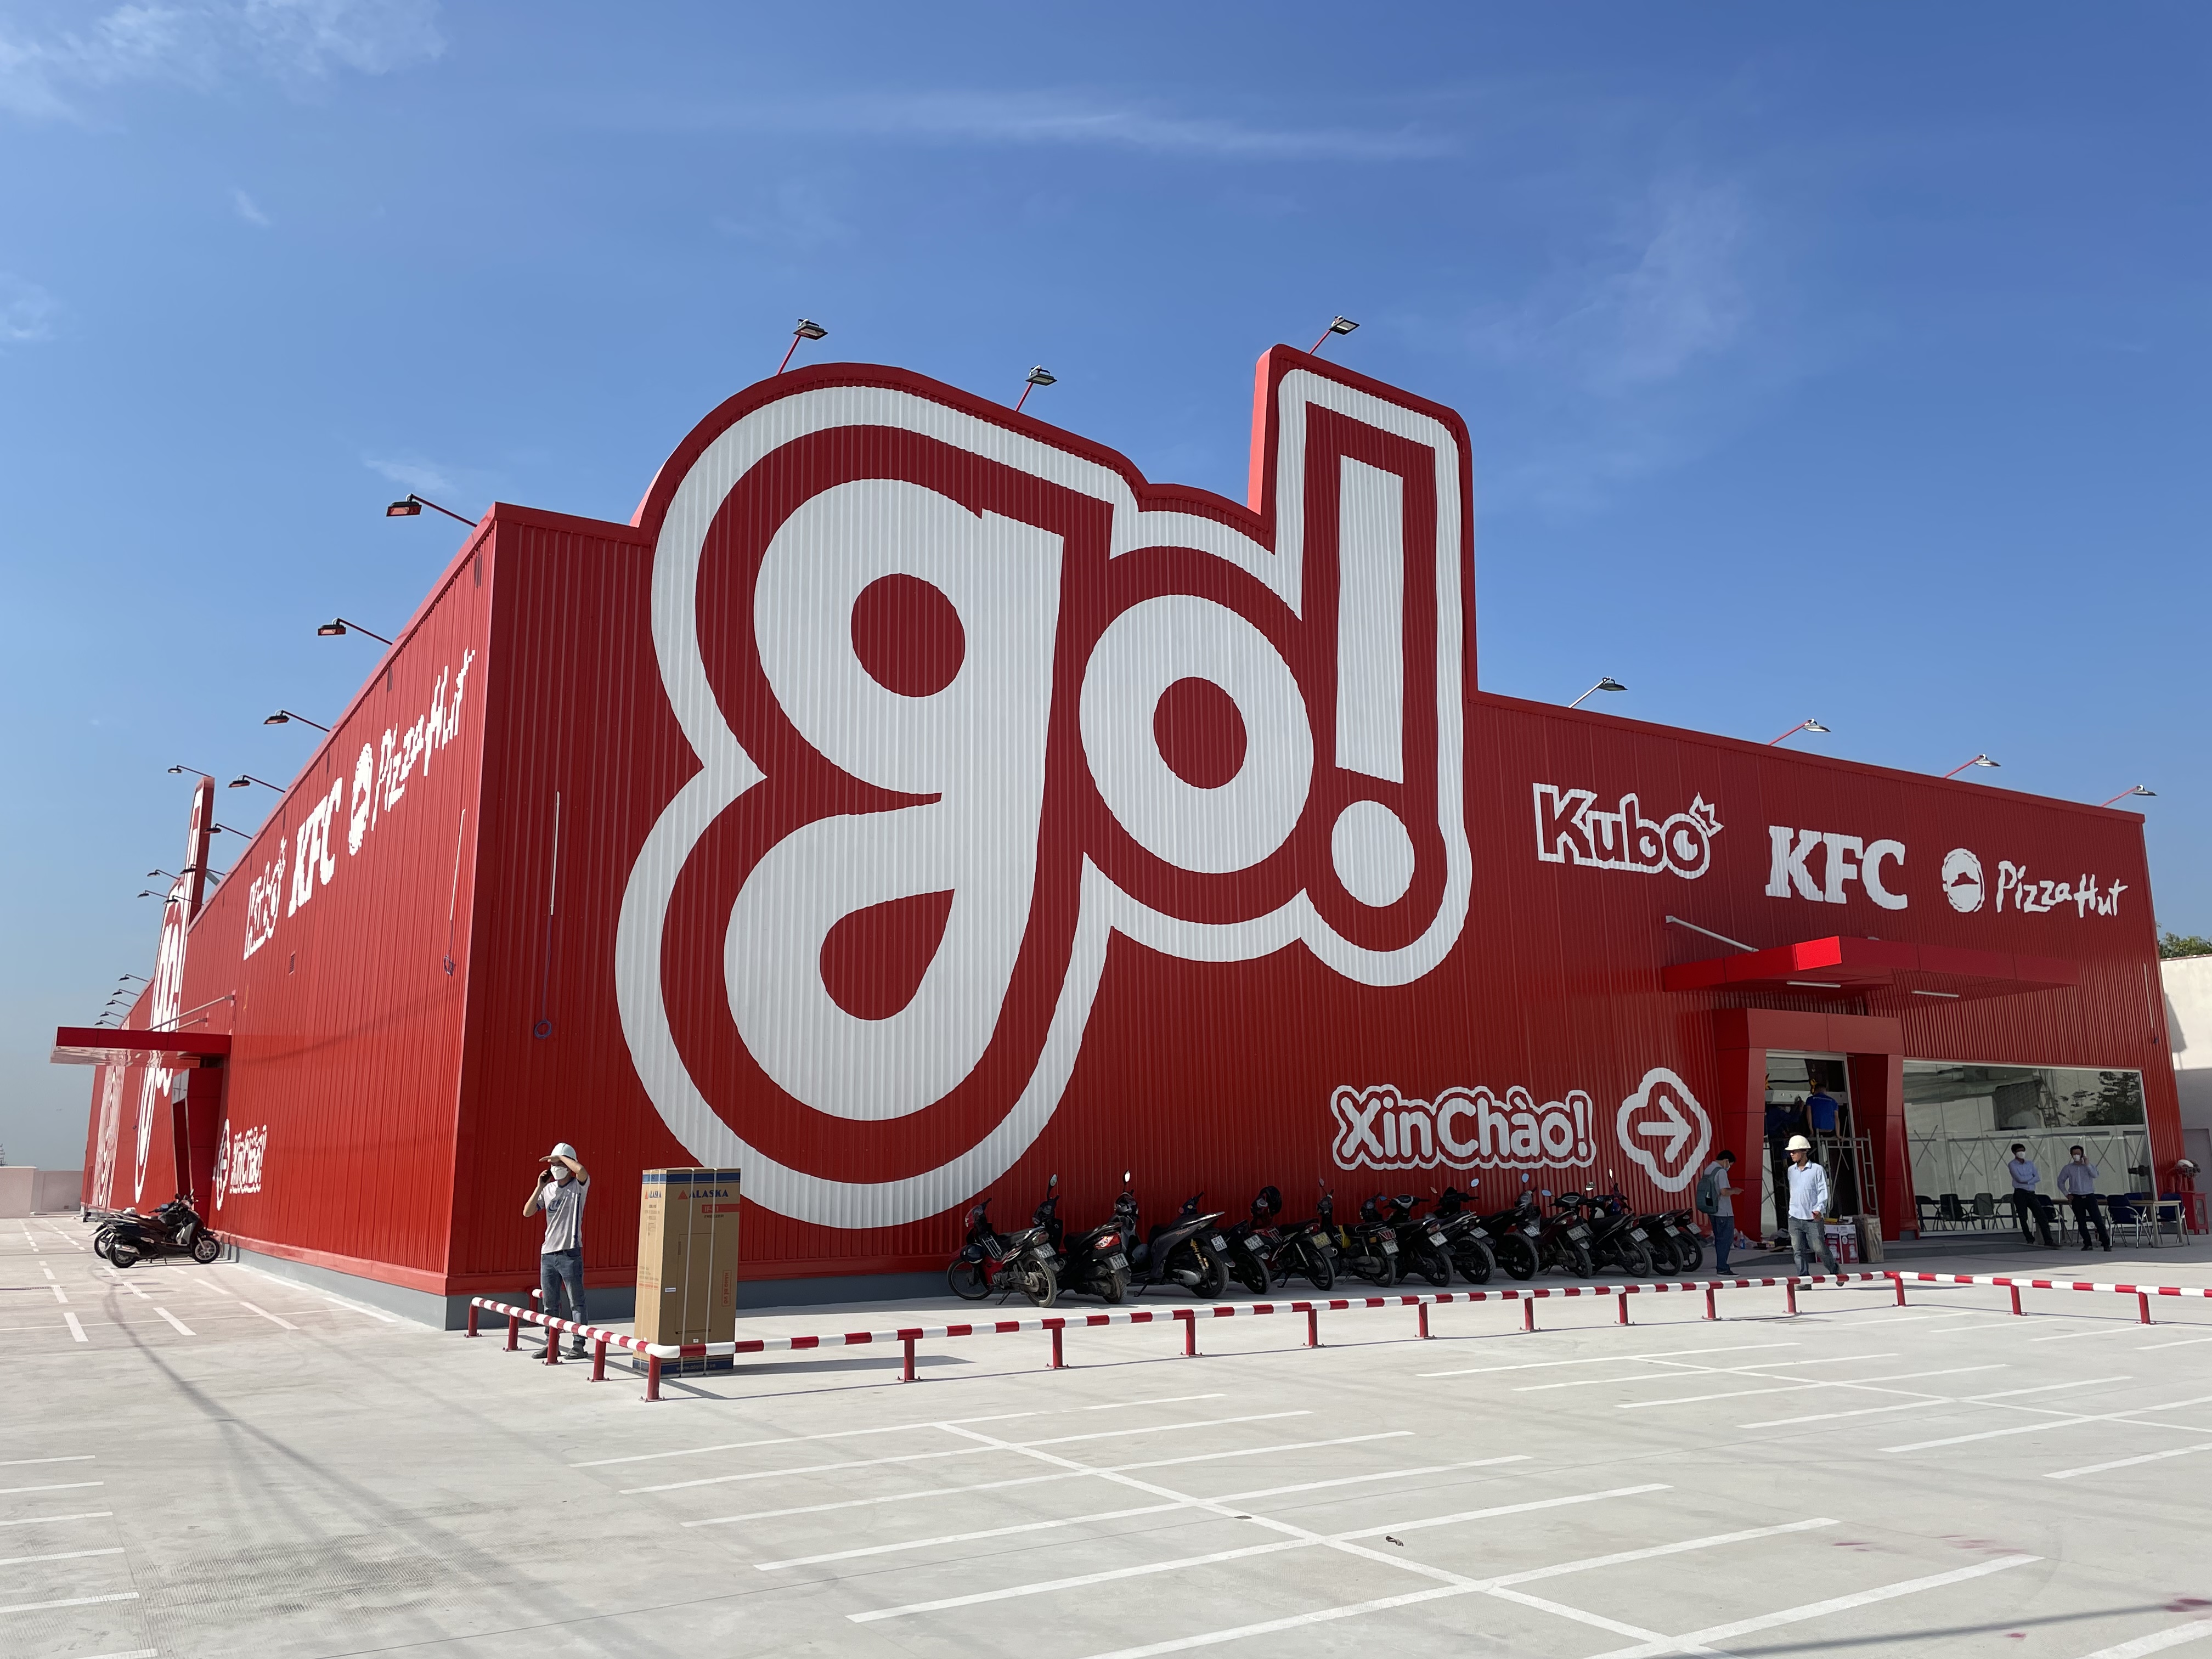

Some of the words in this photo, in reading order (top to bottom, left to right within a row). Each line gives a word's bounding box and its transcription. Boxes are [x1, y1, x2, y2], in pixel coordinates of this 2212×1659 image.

[724, 454, 1415, 1121] go!
[1533, 783, 1714, 879] Kubo
[288, 777, 342, 918] KFC
[1765, 825, 1908, 911] KFC
[689, 1189, 729, 1199] ALASKA
